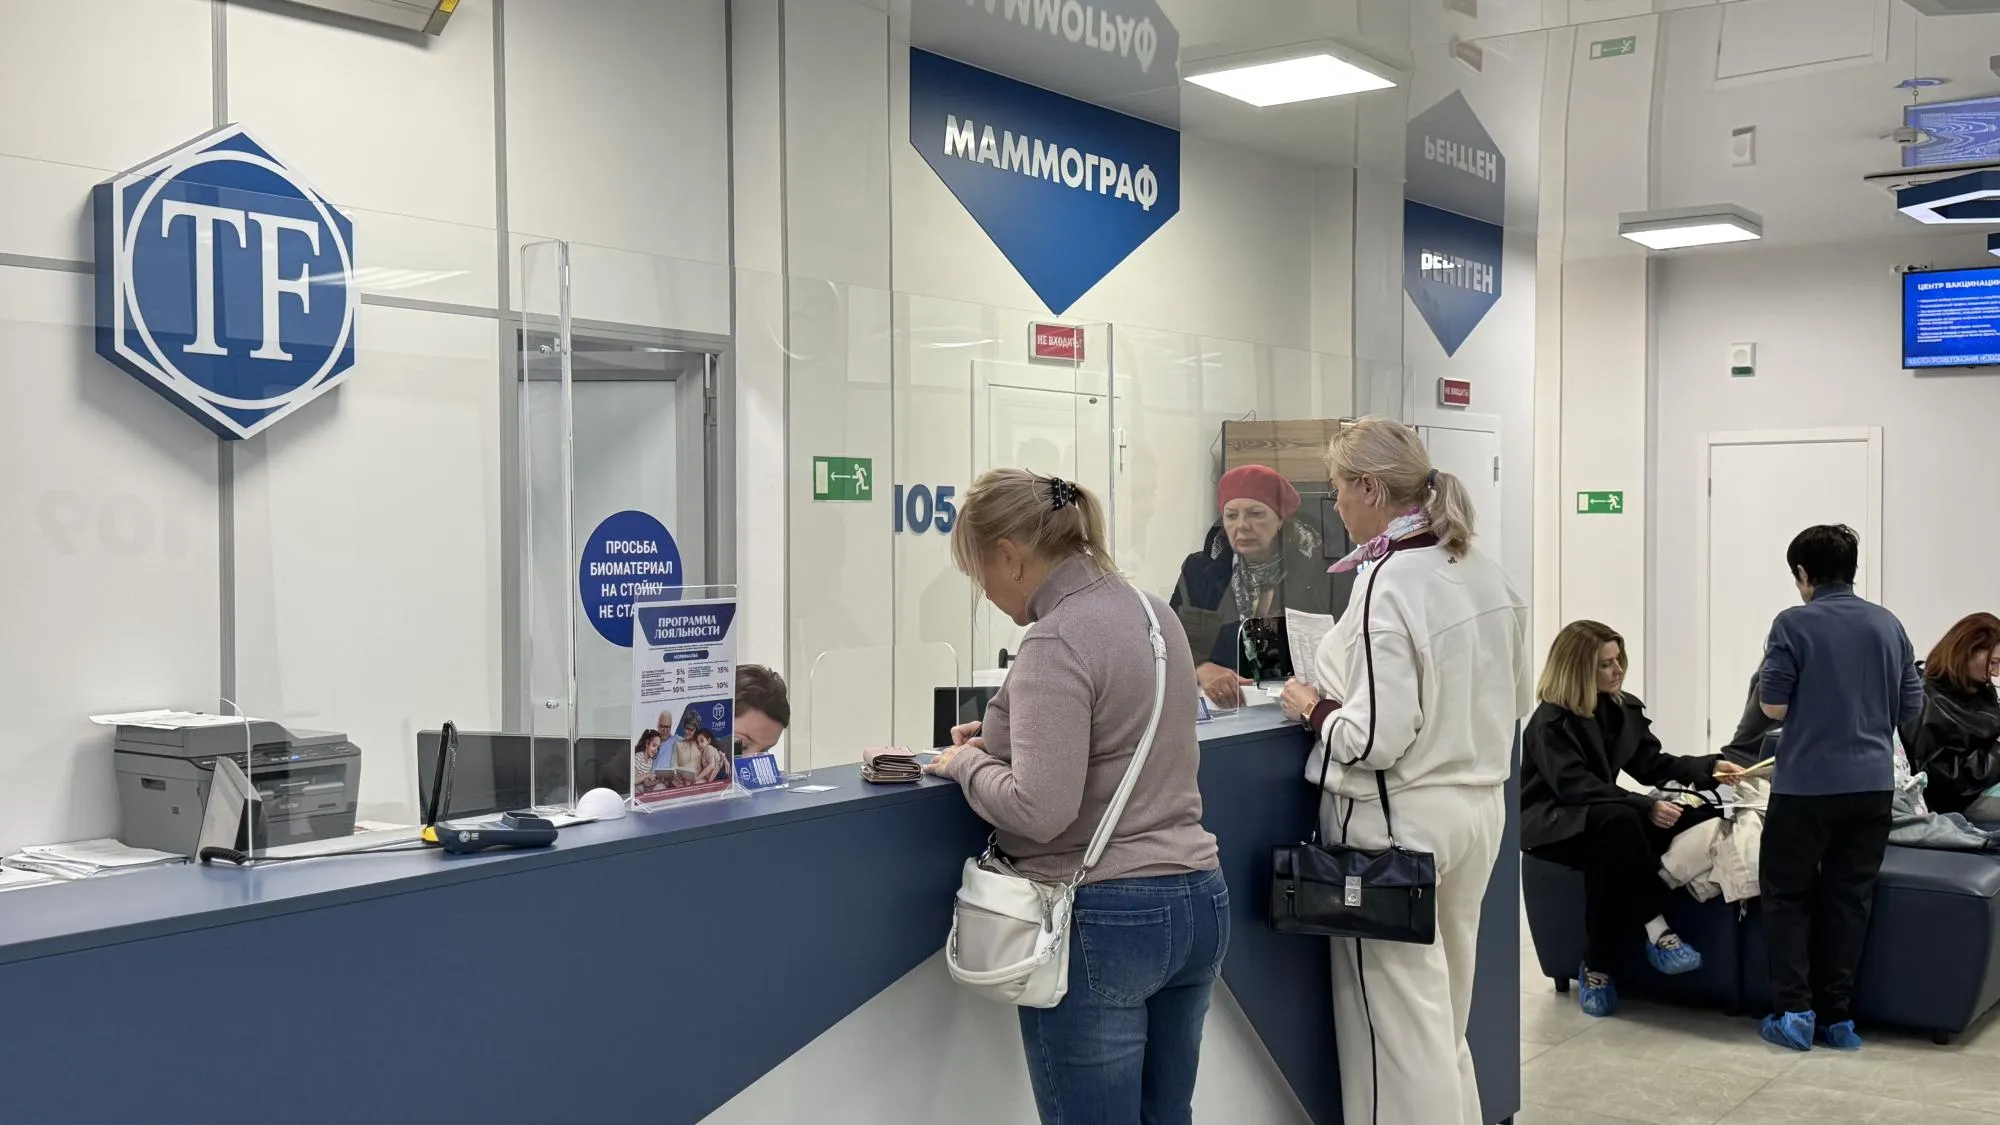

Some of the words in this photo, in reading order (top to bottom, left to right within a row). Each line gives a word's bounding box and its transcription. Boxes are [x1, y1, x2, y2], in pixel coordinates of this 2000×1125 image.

[944, 114, 1158, 211] МАММОГРАФ
[1421, 249, 1493, 294] РЕНТГЕН
[162, 199, 320, 361] TF
[1918, 283, 1944, 291] ЦЕНТР
[1037, 334, 1048, 345] НЕ
[894, 484, 957, 533] 105
[606, 540, 658, 554] ПРОСЬБА
[590, 561, 673, 576] БИОМАТЕРИАЛ
[601, 583, 617, 597] НА
[620, 579, 663, 596] СТОЙКУ
[599, 604, 614, 618] НЕ
[658, 614, 717, 628] ПРОГРАММА
[654, 625, 720, 640] ЛОЯЛЬНОСТИ
[676, 668, 685, 676] 5%
[676, 677, 685, 685] 7%
